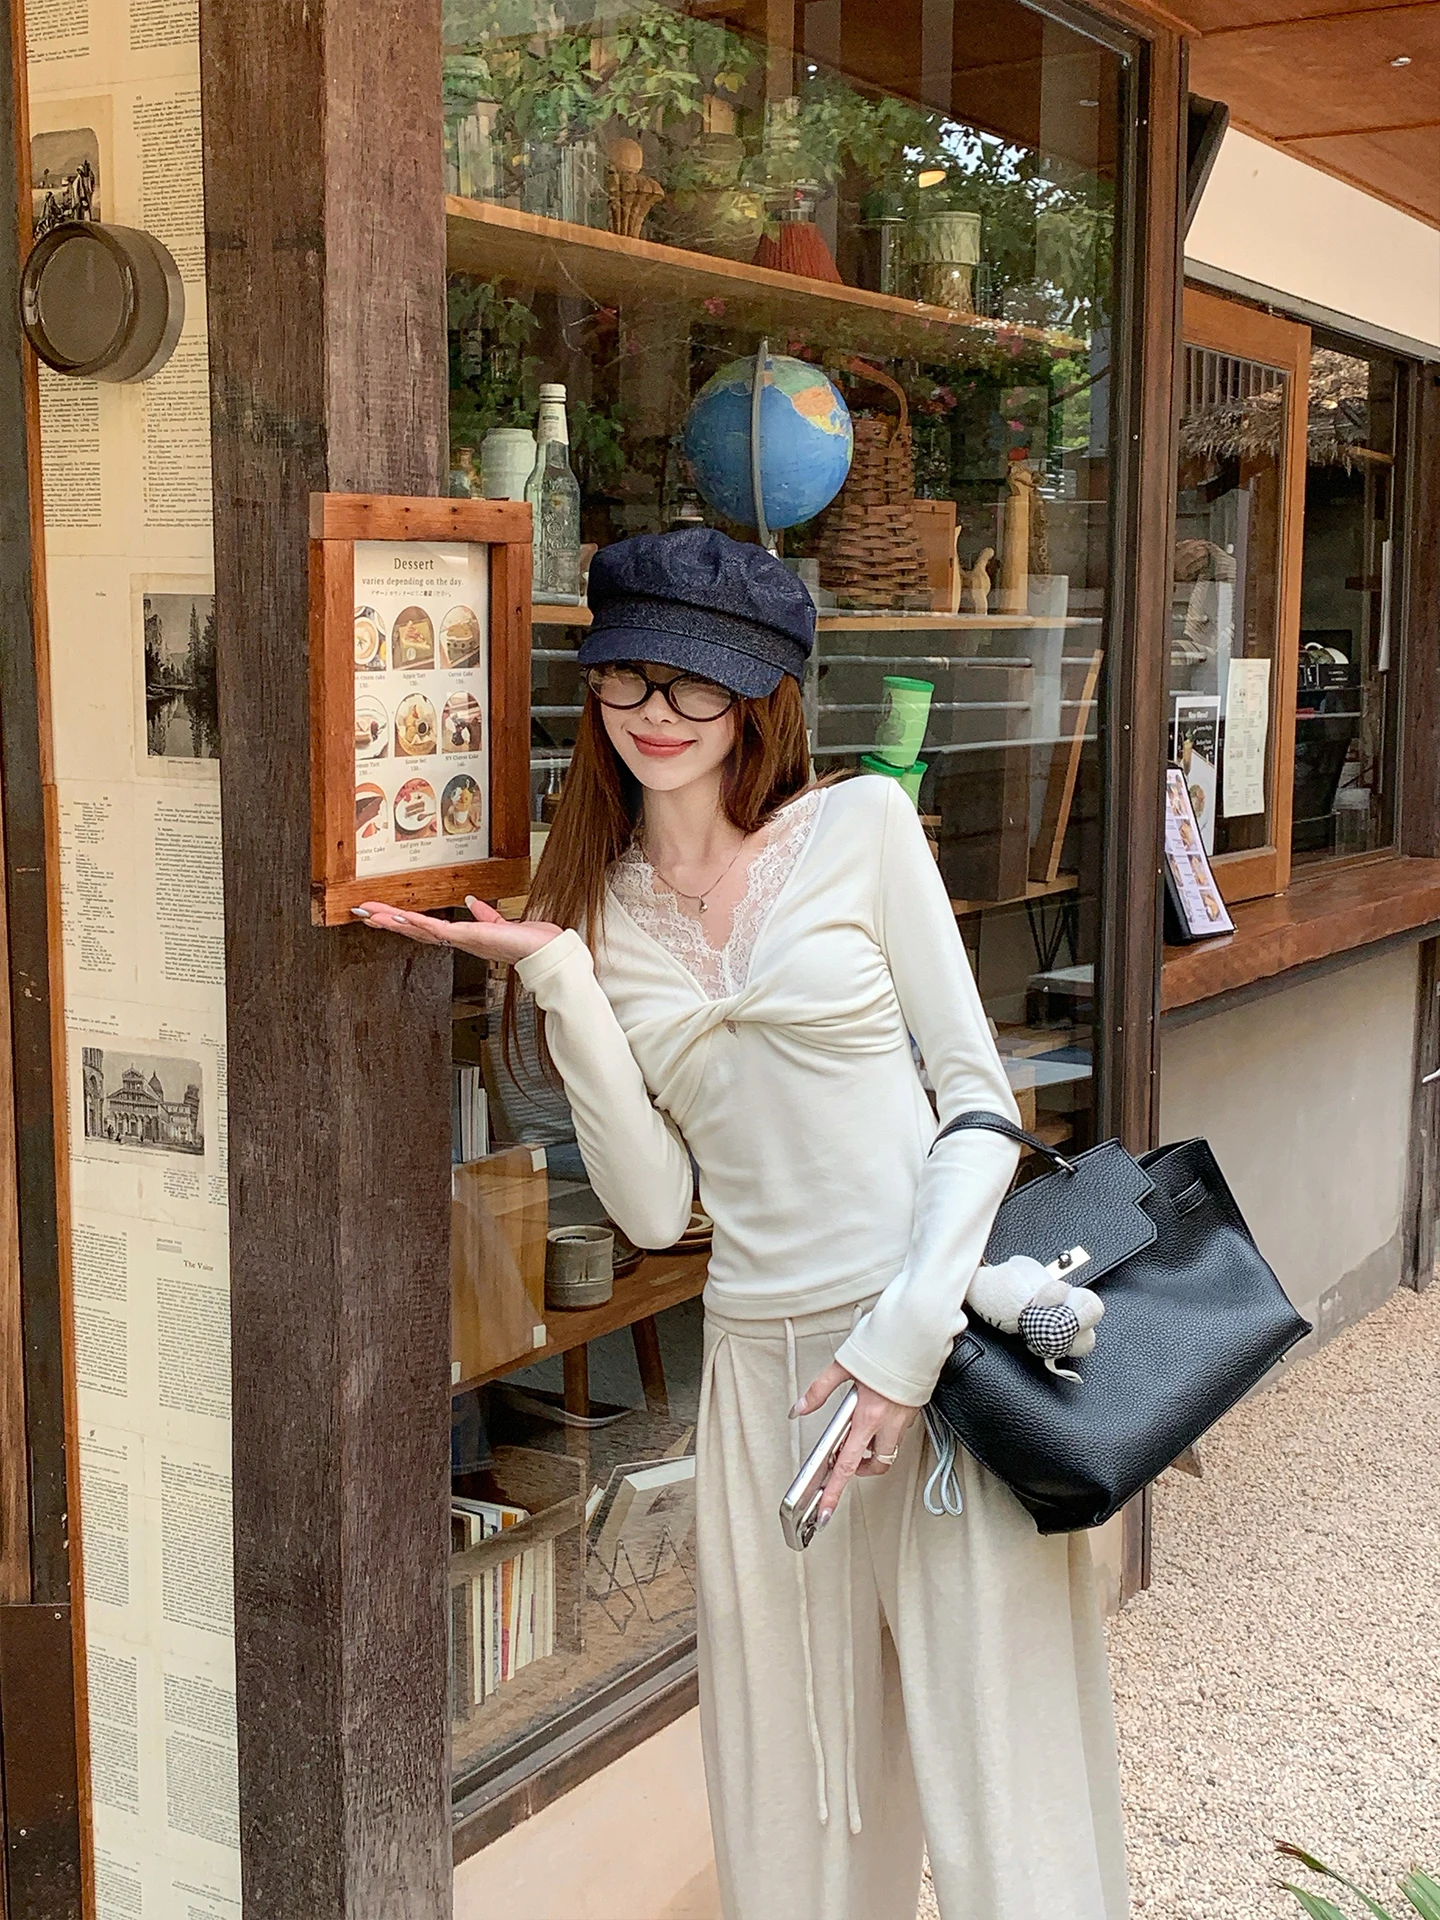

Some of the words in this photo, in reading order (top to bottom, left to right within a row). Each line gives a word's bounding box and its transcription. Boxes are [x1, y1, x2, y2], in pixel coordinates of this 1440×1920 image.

[393, 557, 434, 570] Dessert
[361, 578, 385, 586] varies
[386, 577, 424, 587] depending
[425, 578, 435, 586] on
[436, 577, 448, 586] the
[449, 577, 464, 587] day.
[183, 1259, 196, 1269] The
